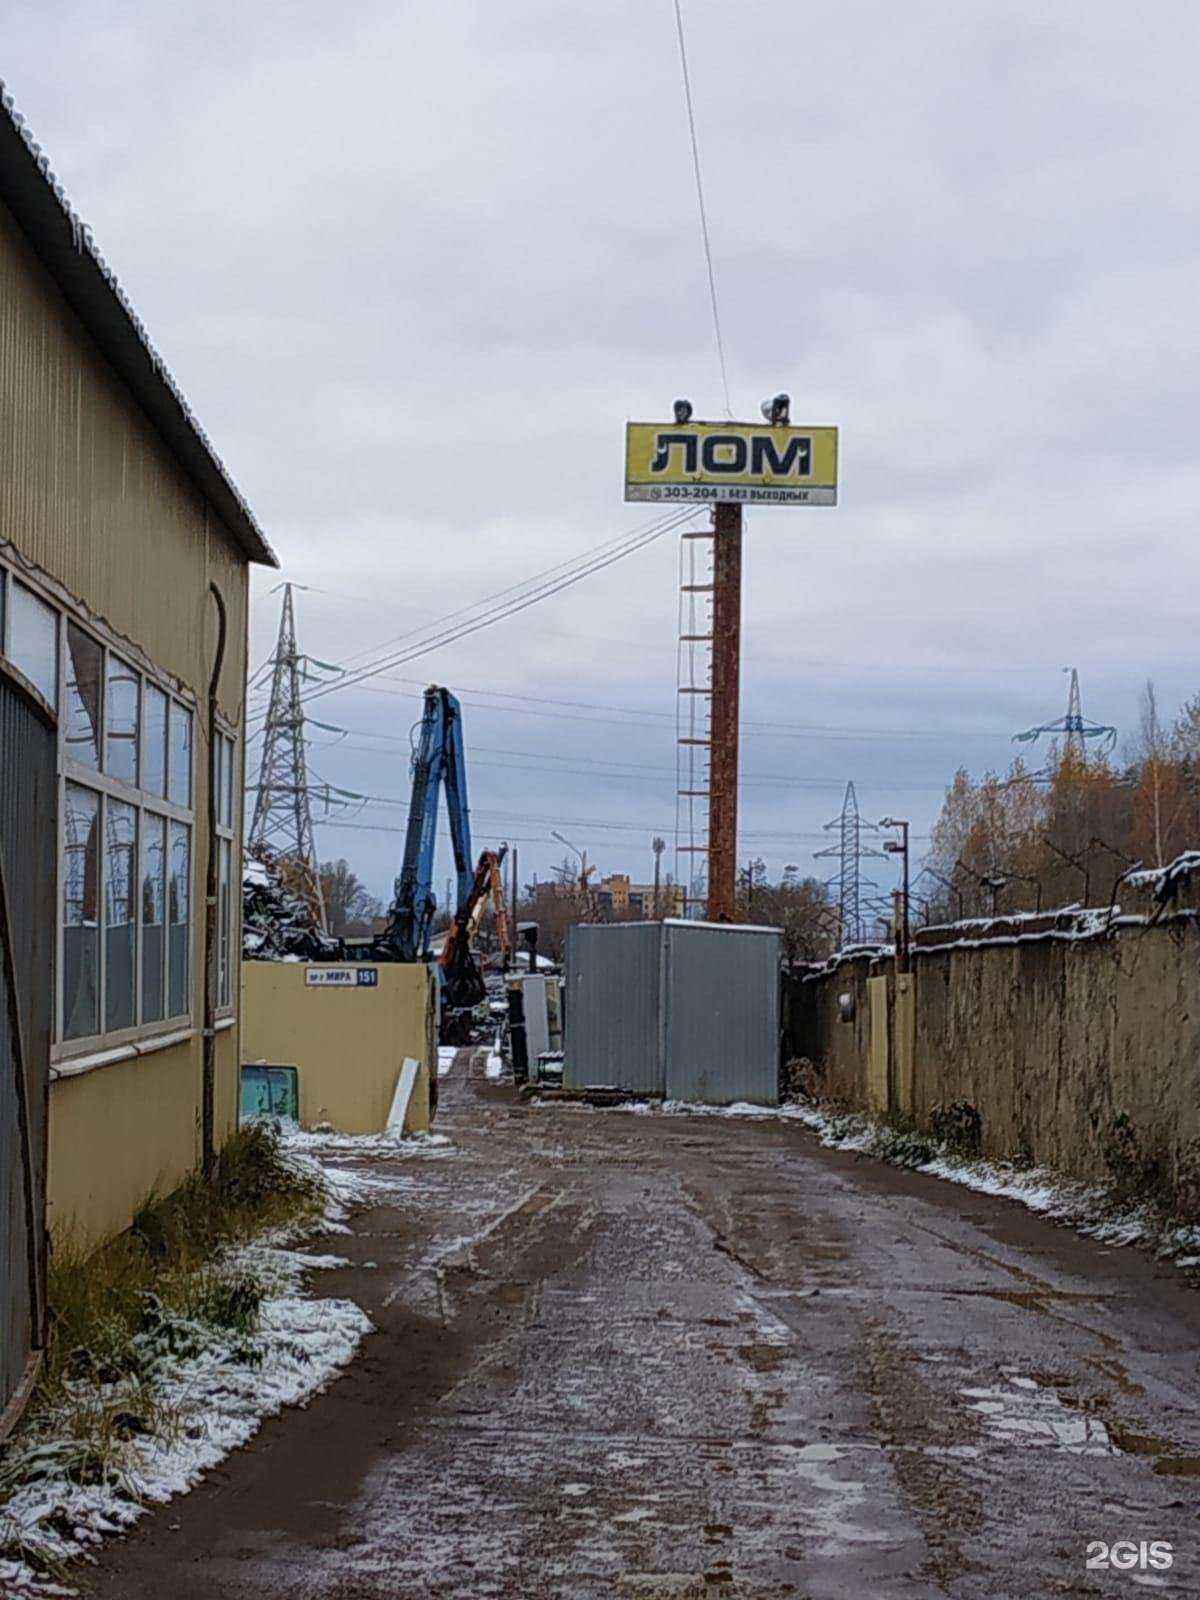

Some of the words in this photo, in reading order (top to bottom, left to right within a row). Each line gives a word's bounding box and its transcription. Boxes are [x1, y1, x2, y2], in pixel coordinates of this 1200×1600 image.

[651, 434, 811, 476] ЛОМ
[664, 487, 718, 498] 303-204
[359, 970, 376, 984] 151
